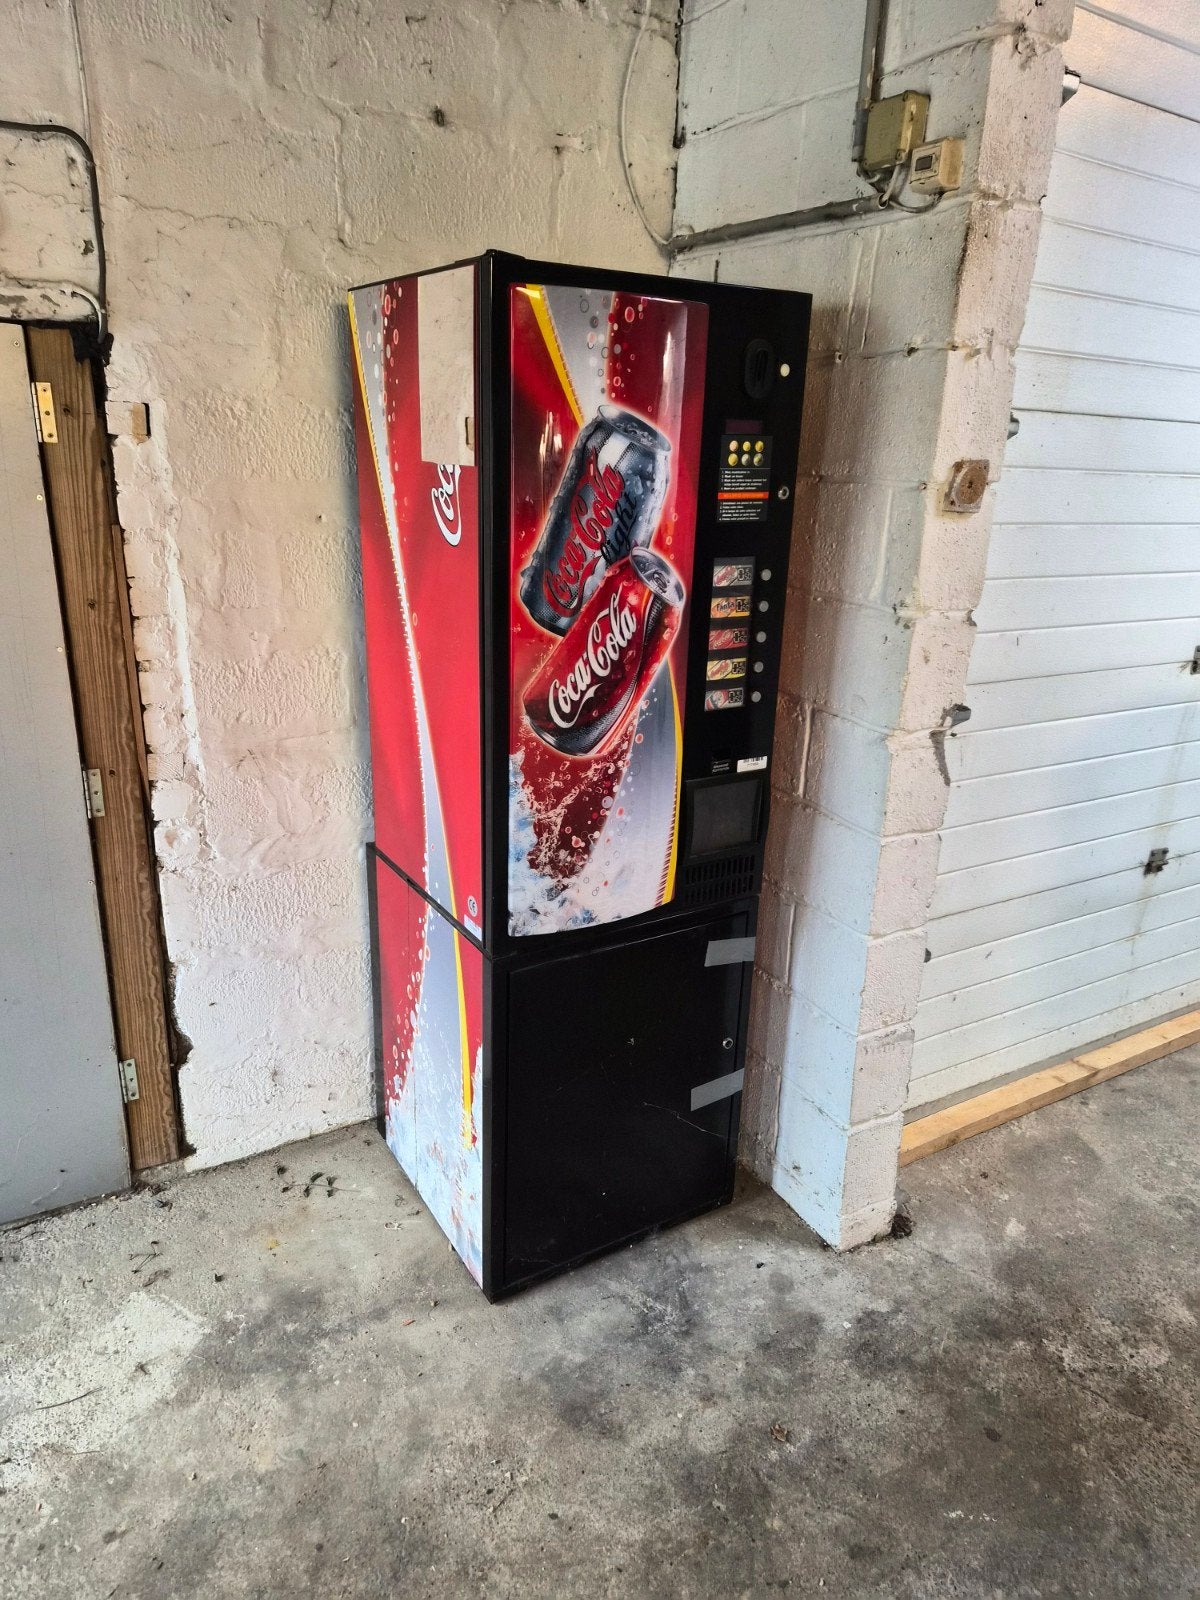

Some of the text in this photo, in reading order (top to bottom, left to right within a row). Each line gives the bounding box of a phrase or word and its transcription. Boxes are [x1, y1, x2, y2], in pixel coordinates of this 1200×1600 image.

[543, 445, 625, 618] Coca-Cola
[548, 582, 638, 729] Coca-Cola
[716, 601, 736, 612] Fanta
